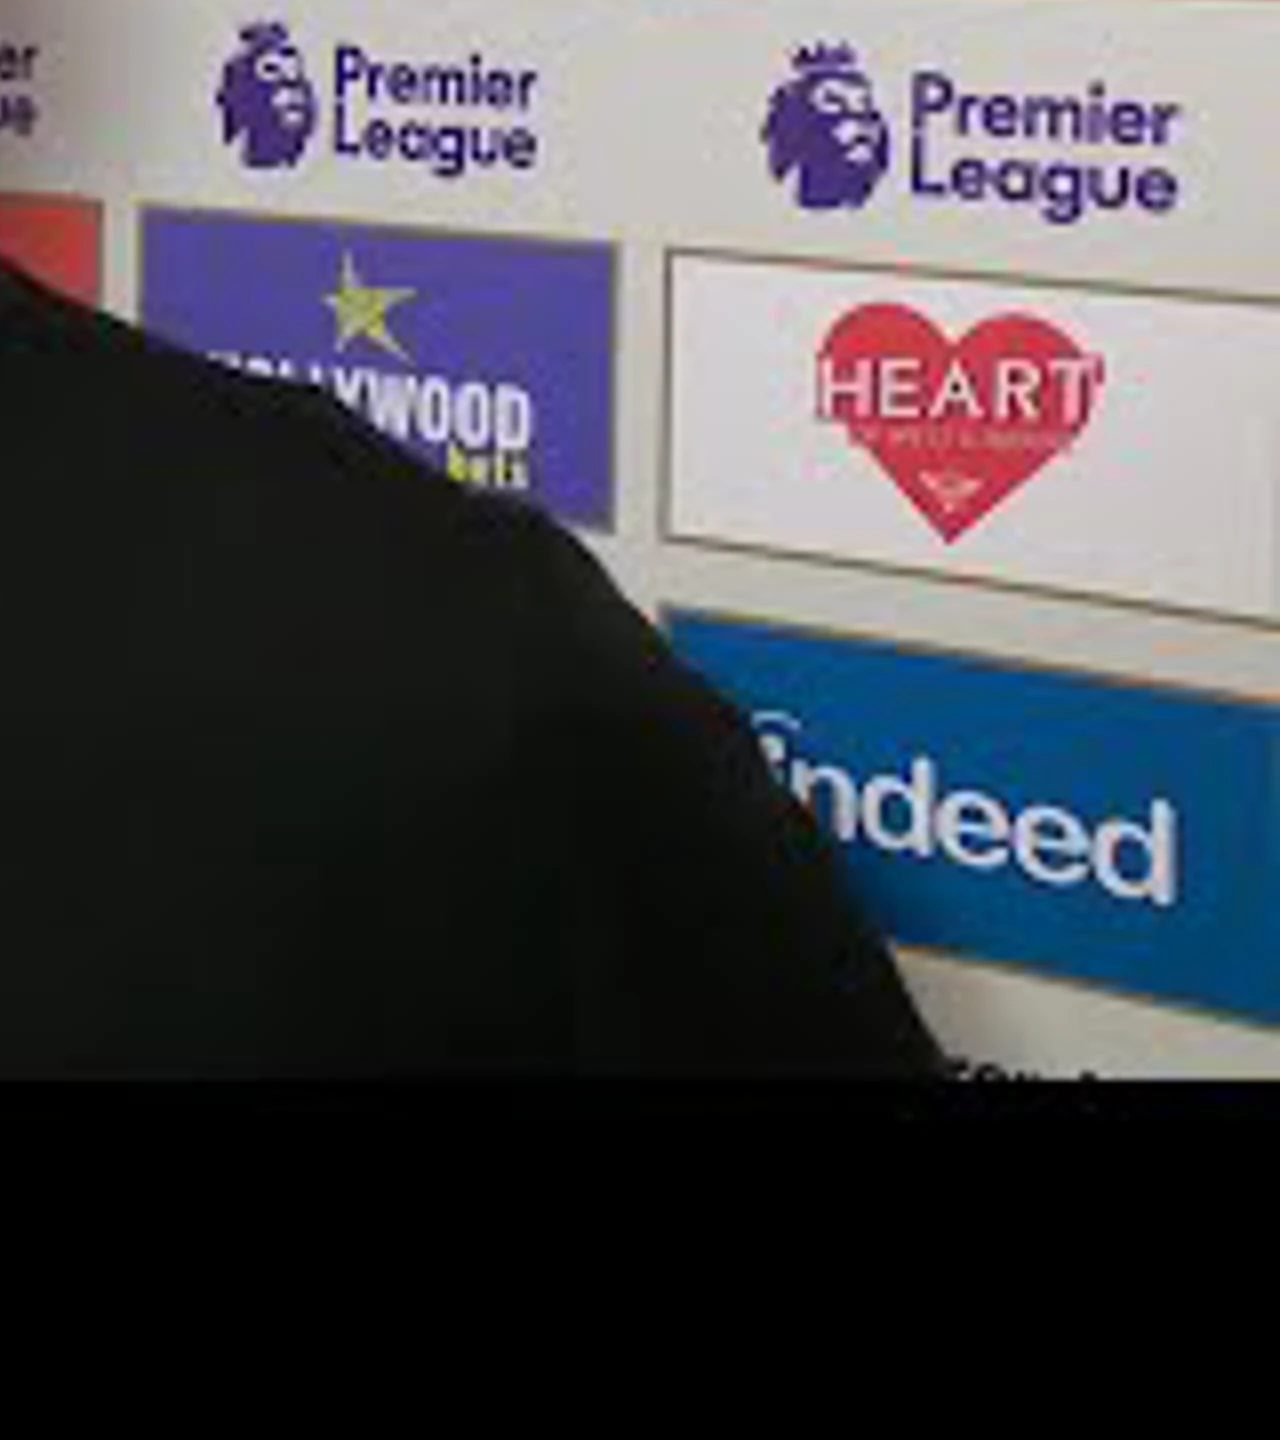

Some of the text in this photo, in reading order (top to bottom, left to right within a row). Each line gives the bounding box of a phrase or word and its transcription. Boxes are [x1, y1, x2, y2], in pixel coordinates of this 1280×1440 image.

[334, 46, 537, 110] Premier
[911, 72, 1182, 145] Premier
[334, 108, 537, 177] League
[911, 134, 1180, 224] League
[816, 356, 1104, 420] HEART
